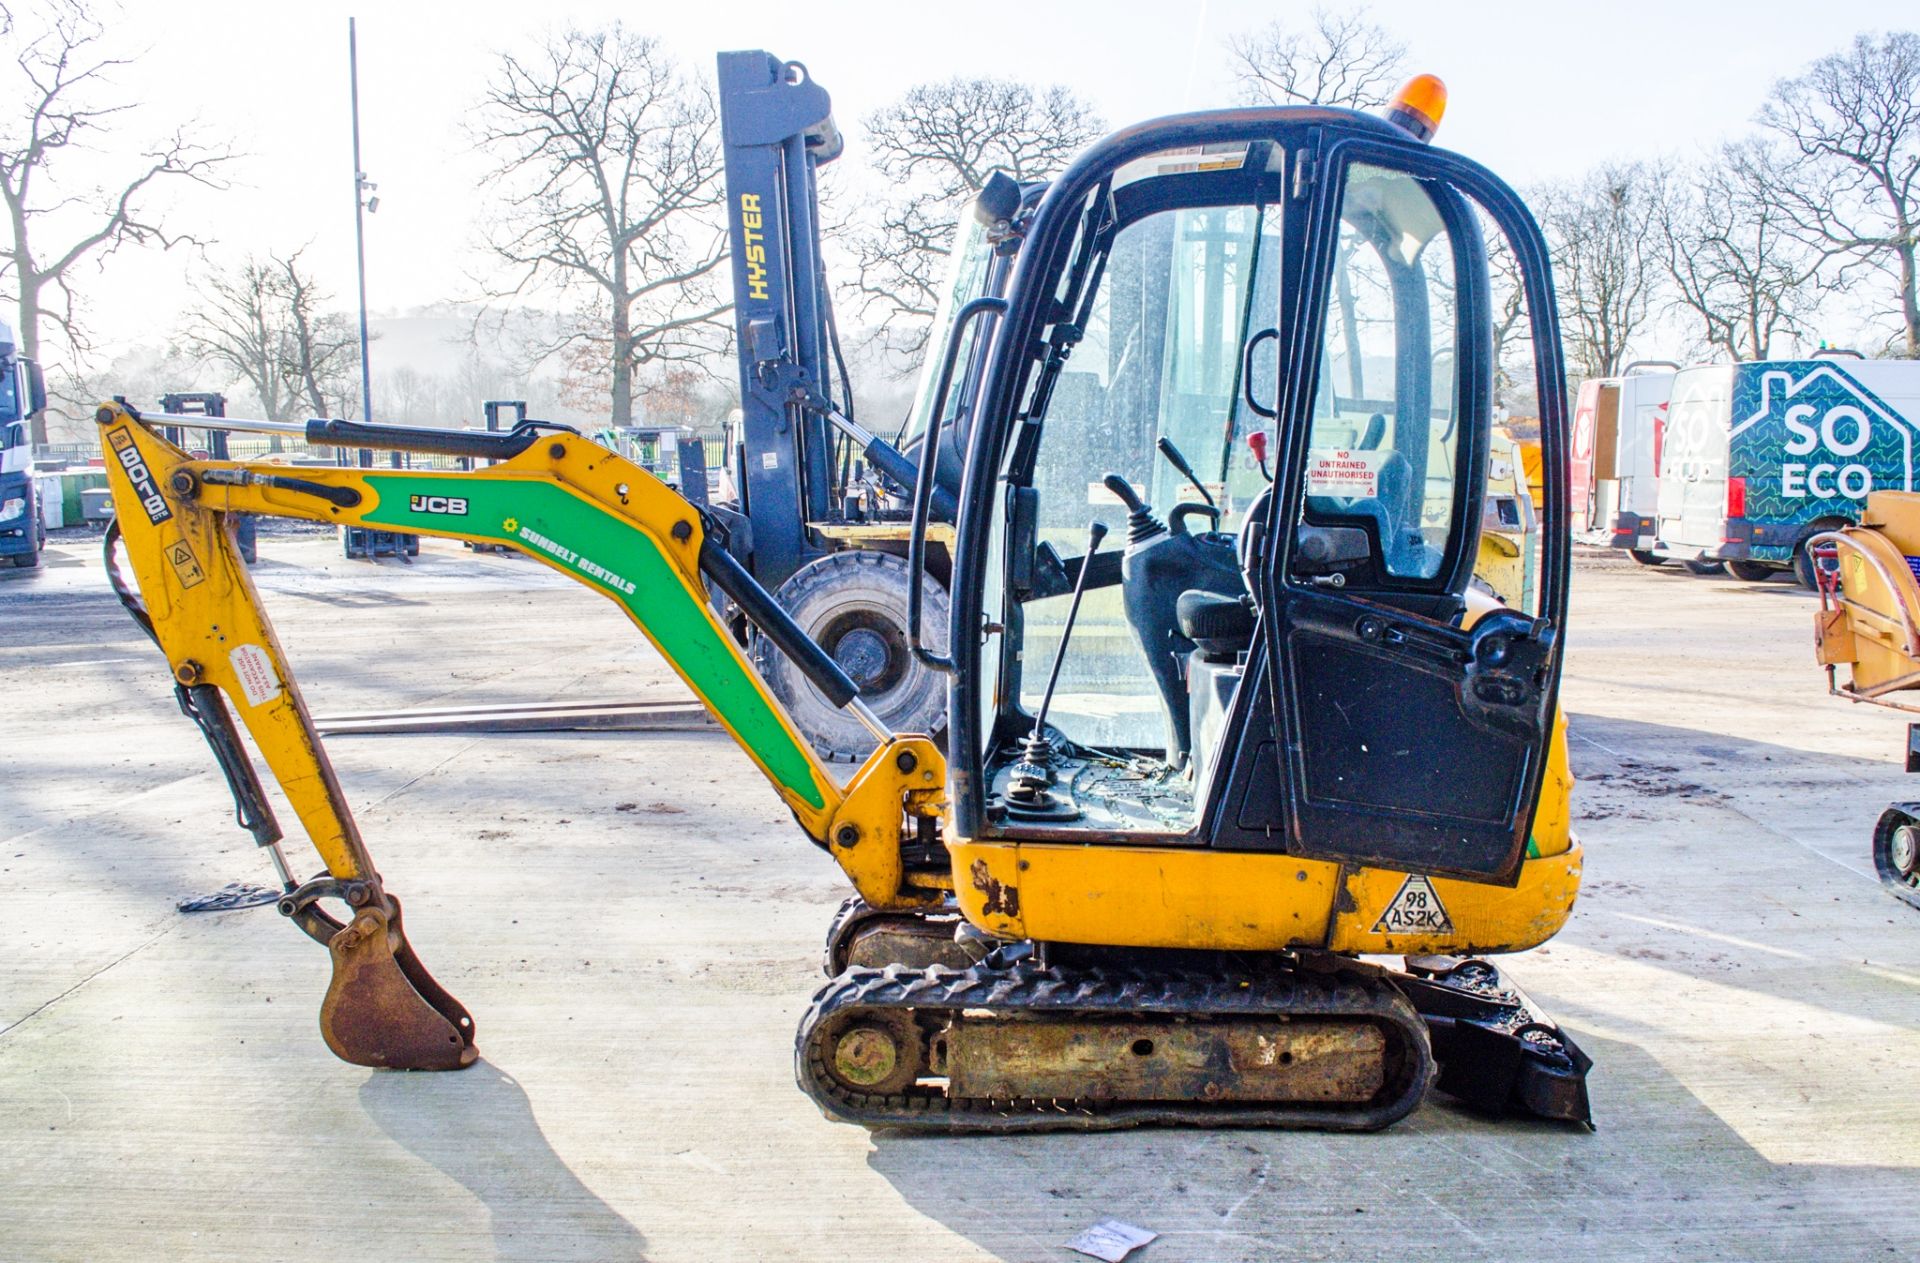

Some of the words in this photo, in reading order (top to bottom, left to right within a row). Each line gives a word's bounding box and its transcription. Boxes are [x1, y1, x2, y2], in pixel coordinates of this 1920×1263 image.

[741, 193, 769, 299] HYSTER
[1676, 409, 1709, 452] SO
[1783, 404, 1871, 456] SO
[1337, 451, 1350, 459] NO
[1319, 460, 1367, 469] UNTRAINED
[119, 447, 166, 515] 8018
[1311, 470, 1375, 479] UNAUTHORISED
[1782, 463, 1872, 499] ECO
[411, 496, 468, 514] JCB
[519, 526, 579, 564] SUNBELT
[577, 556, 637, 595] RENTALS
[238, 656, 246, 670] USE
[240, 646, 261, 684] EXCAVATOR
[252, 652, 264, 674] CRANE
[243, 671, 252, 685] NOT
[250, 685, 257, 696] DO
[1406, 891, 1427, 908] 98
[1391, 910, 1439, 928] AS2K
